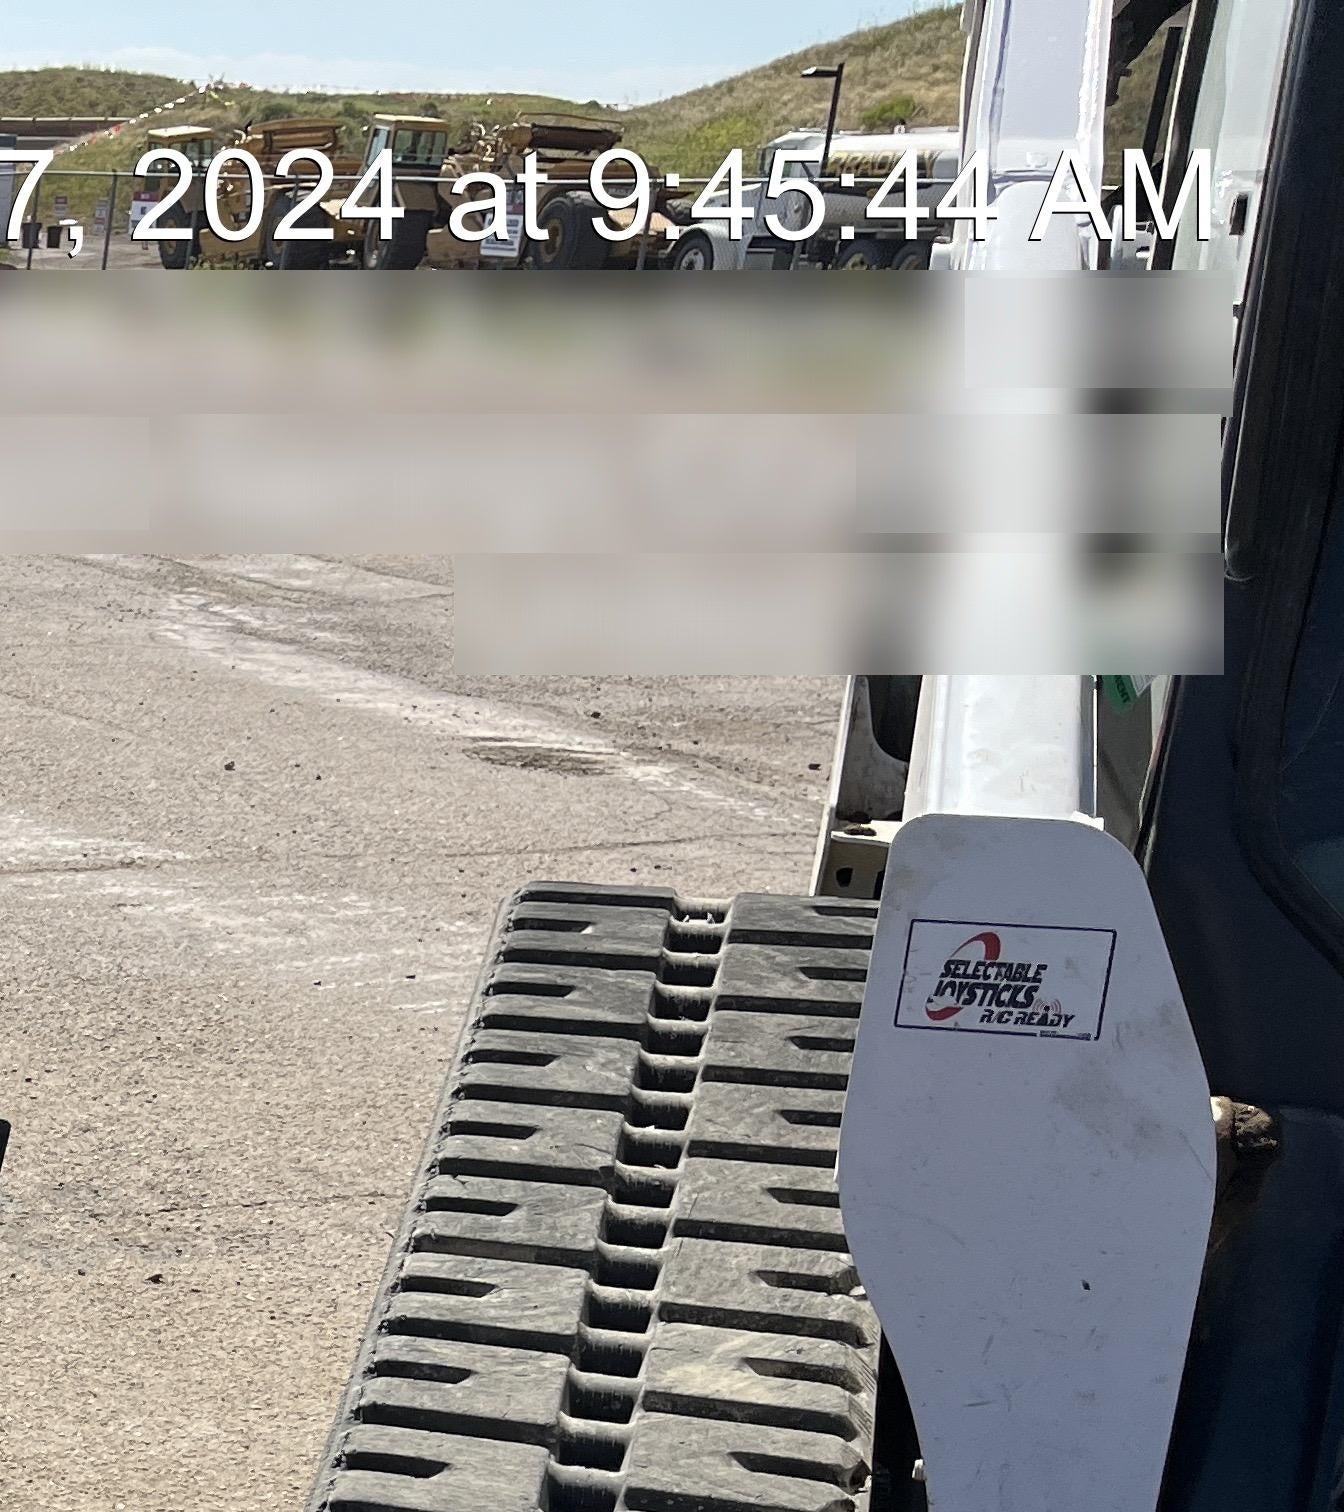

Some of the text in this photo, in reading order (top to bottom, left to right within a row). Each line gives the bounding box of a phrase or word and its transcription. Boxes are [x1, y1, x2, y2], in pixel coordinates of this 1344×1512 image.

[939, 959, 1048, 984] SELECTABLE
[928, 980, 1041, 1009] JOYSTICKS
[979, 1008, 1076, 1028] R/C READY
